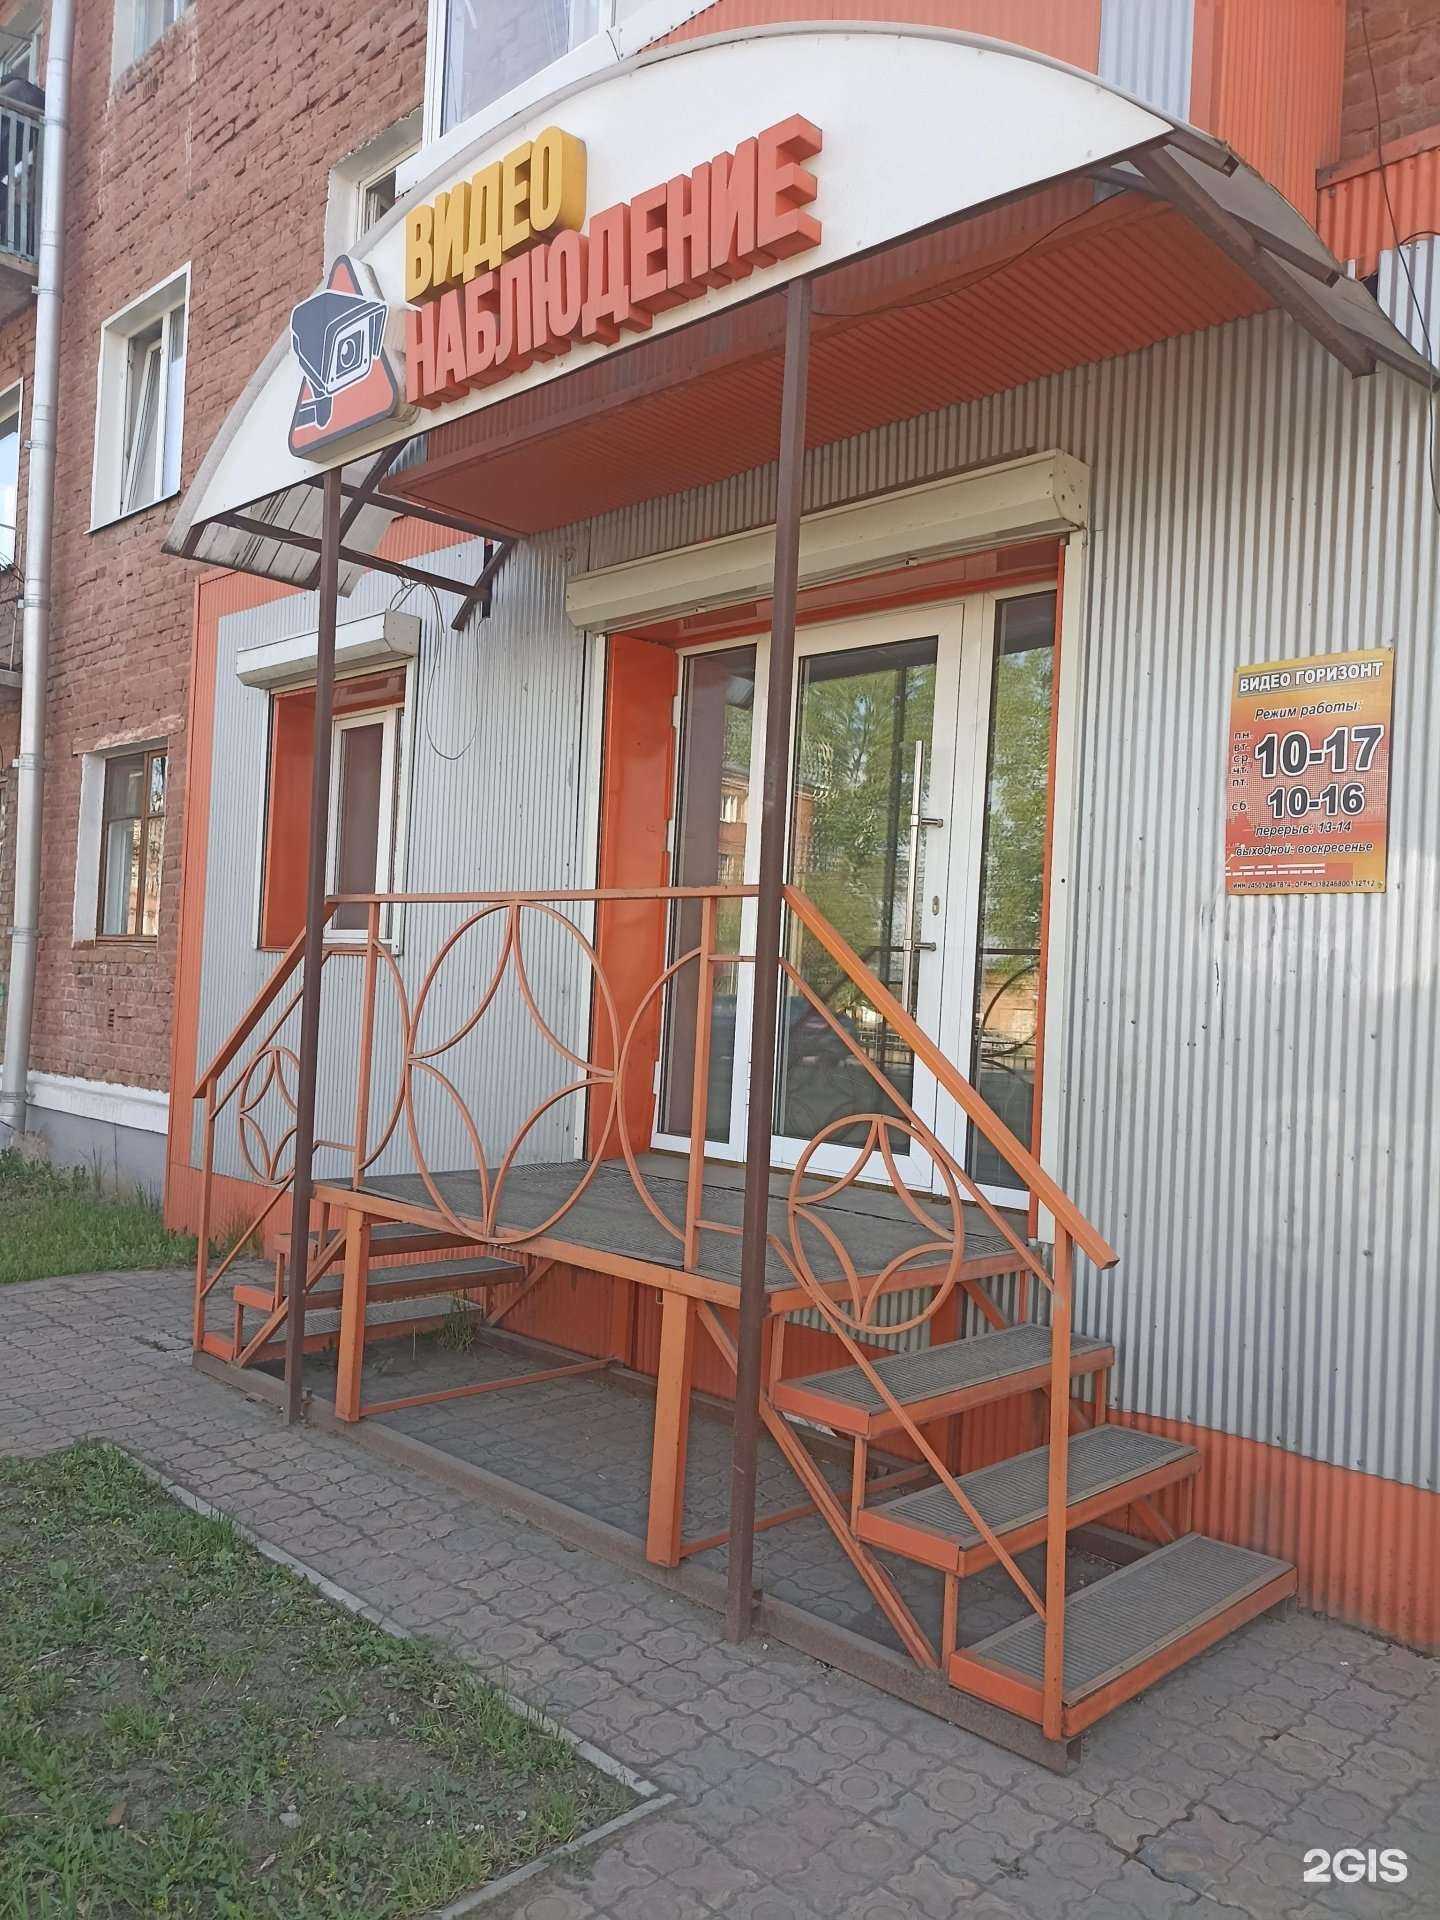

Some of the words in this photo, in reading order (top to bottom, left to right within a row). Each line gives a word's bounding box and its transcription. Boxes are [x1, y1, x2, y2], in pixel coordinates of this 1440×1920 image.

[404, 125, 587, 306] ВИДЕО
[405, 112, 823, 411] НАБЛЮДЕНИЕ
[1240, 673, 1291, 692] ВИДЕО
[1296, 662, 1383, 685] ГОРИЗОНТ
[1255, 707, 1297, 720] Режим
[1300, 702, 1361, 718] работы:
[1255, 725, 1384, 778] 10-17
[1267, 782, 1365, 818] 10-16
[1255, 824, 1313, 837] перерыв:
[1319, 820, 1352, 832] 13-14
[1236, 843, 1294, 857] выходной:
[1298, 841, 1373, 855] воскресенье
